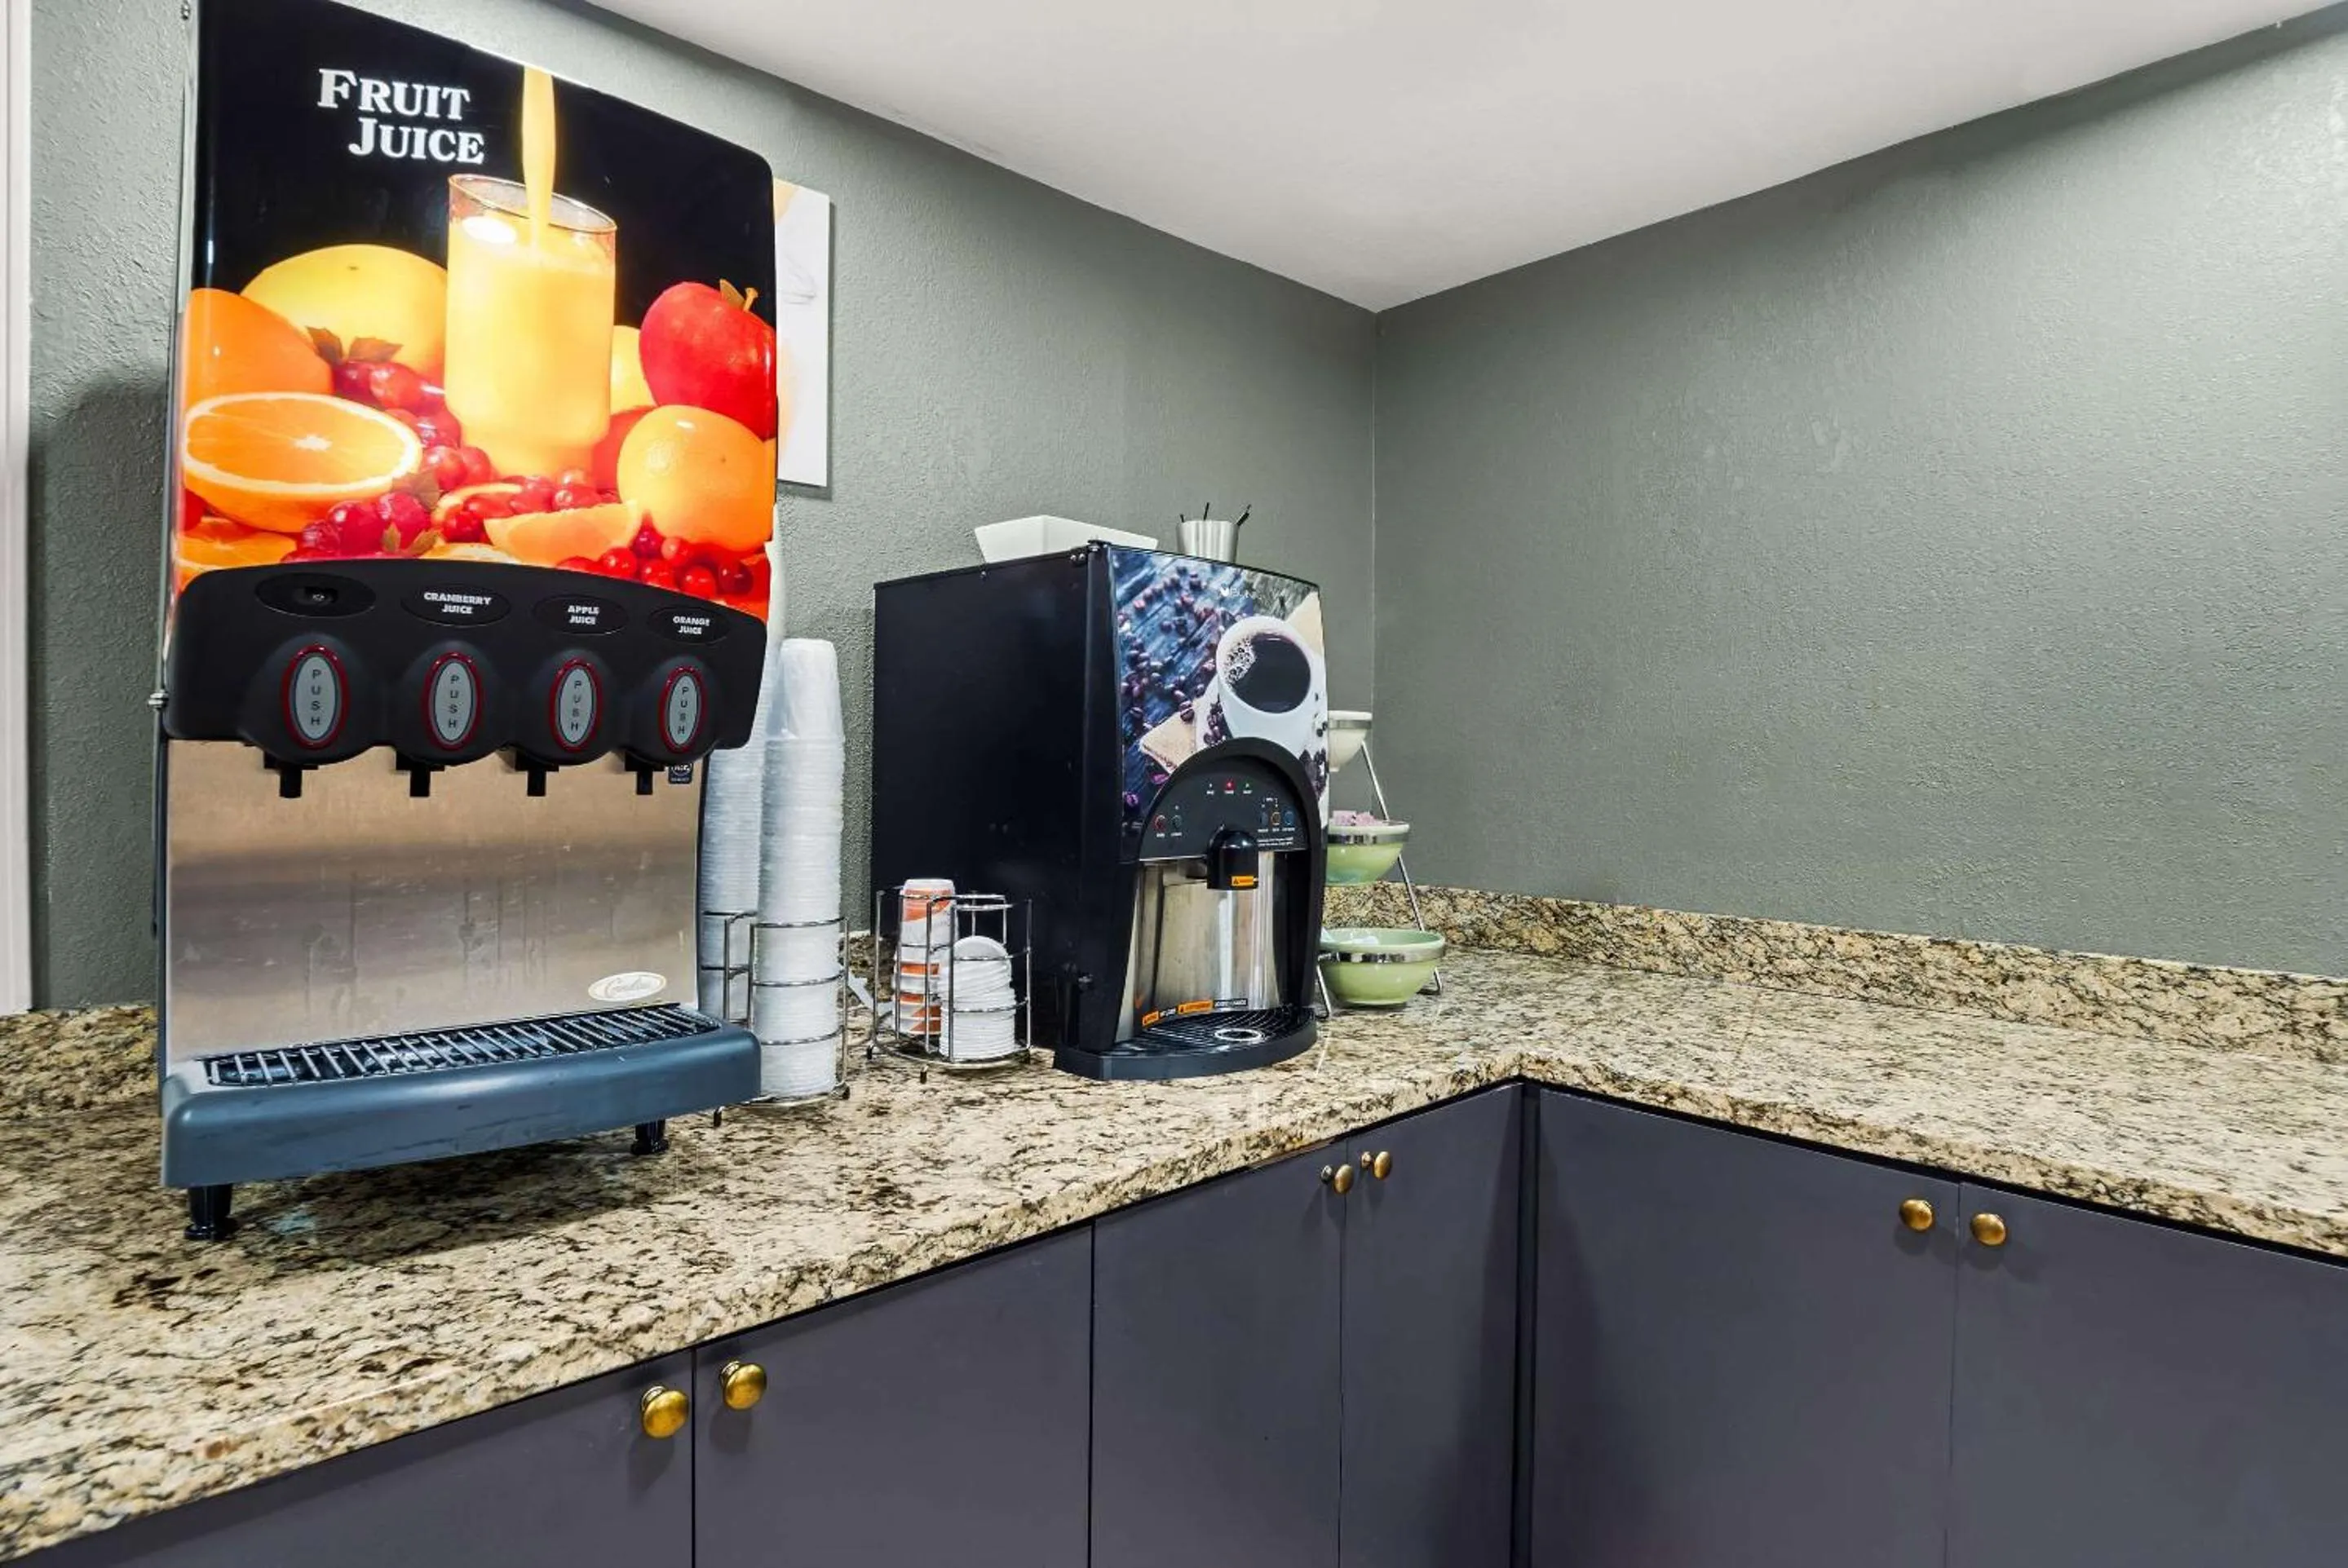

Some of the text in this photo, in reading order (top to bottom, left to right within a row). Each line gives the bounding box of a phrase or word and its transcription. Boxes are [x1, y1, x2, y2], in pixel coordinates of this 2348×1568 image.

[317, 68, 471, 120] FRUIT
[347, 117, 485, 164] JUICE
[424, 592, 492, 605] CRANBERRY
[441, 603, 473, 614] JUICE
[568, 605, 599, 614] APPLE
[569, 615, 596, 625] JUICE
[672, 616, 710, 626] ORANGE
[678, 625, 702, 634] JUICE
[310, 669, 322, 726] PUSH
[448, 674, 460, 729] PUSH
[570, 680, 582, 731] PUSH
[677, 686, 689, 734] PUSH
